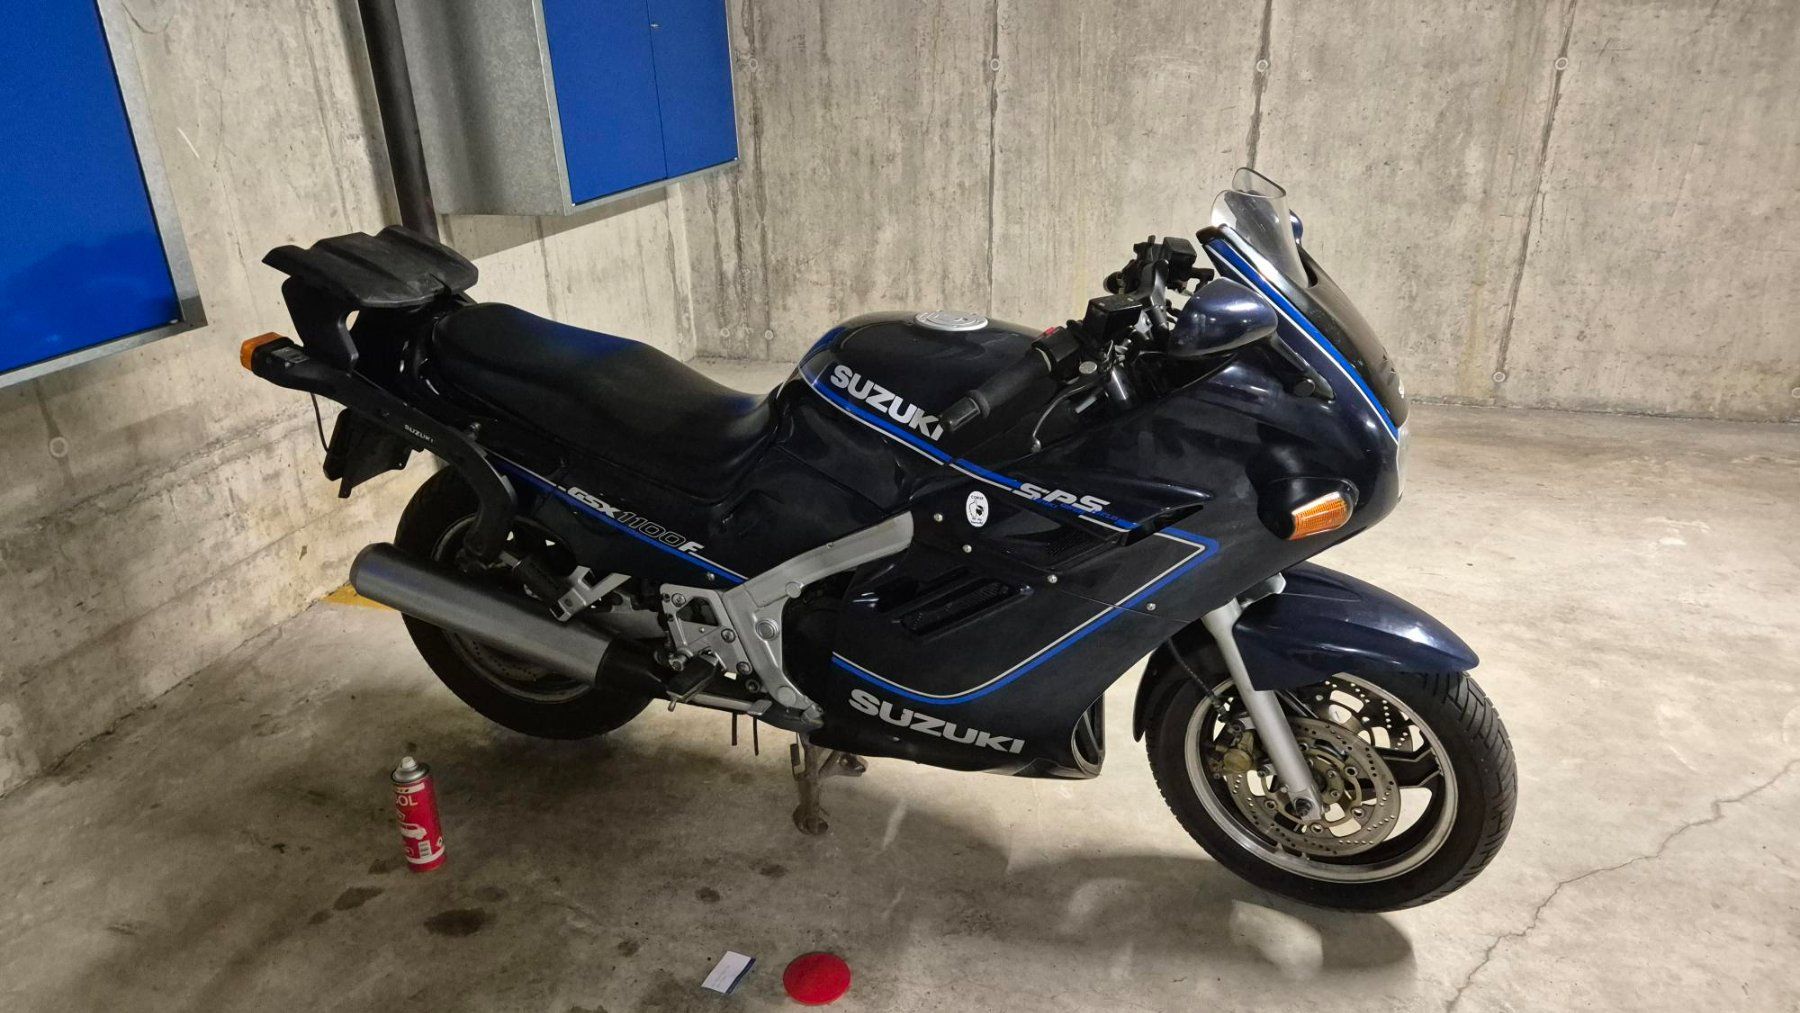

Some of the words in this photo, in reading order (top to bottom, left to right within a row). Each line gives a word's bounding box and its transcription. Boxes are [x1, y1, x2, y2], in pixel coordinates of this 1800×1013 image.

[404, 424, 434, 443] SUZUKI
[830, 364, 944, 441] SUZUKI
[567, 486, 704, 552] GSX1100F
[849, 688, 1025, 754] SUZUKI
